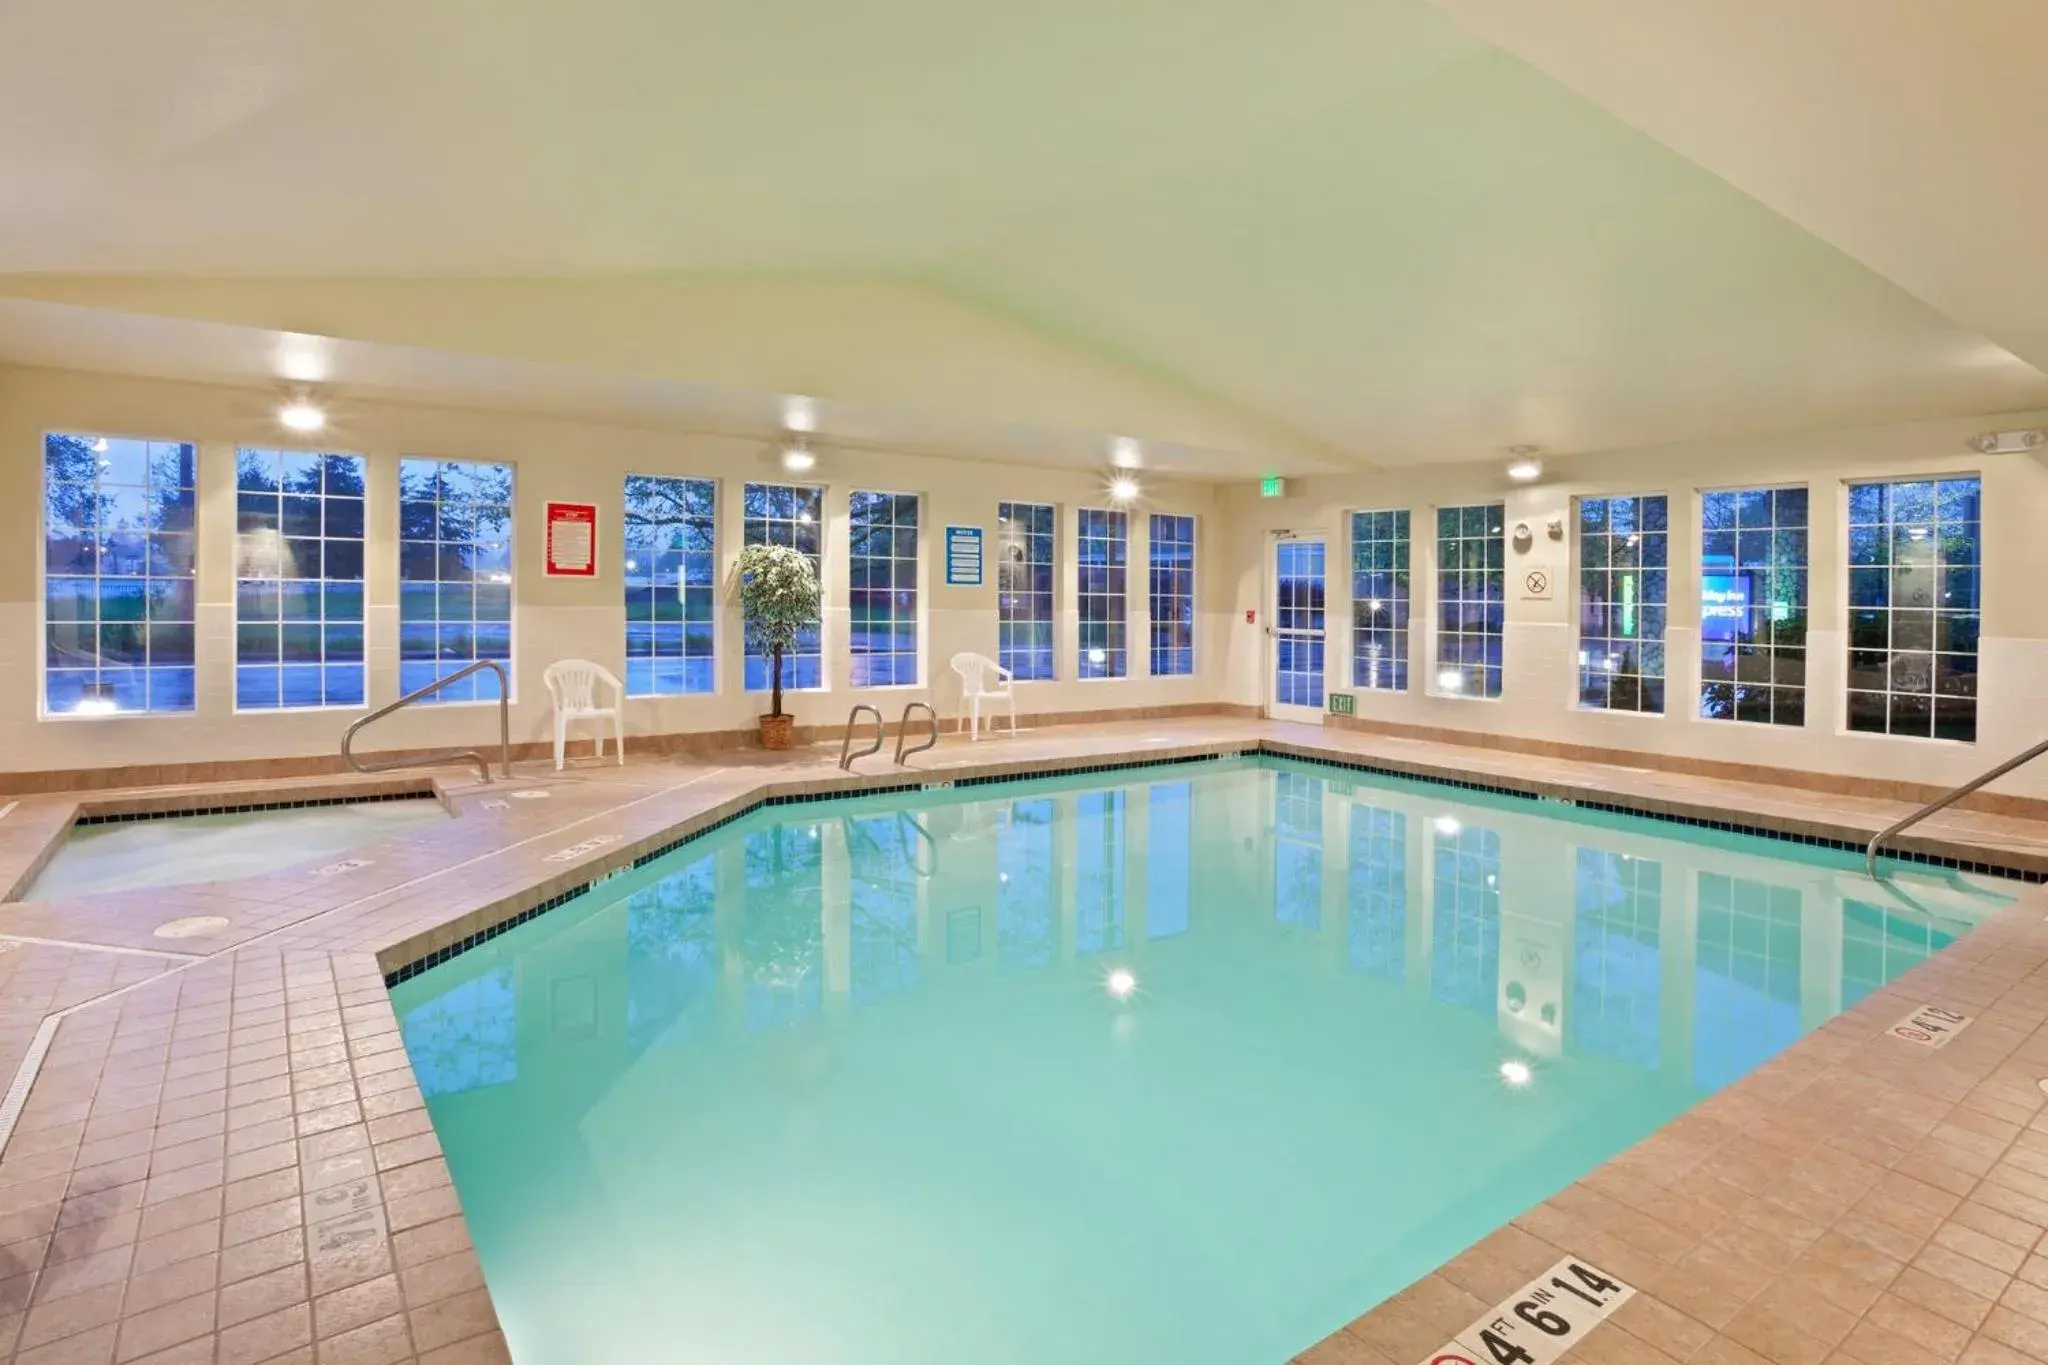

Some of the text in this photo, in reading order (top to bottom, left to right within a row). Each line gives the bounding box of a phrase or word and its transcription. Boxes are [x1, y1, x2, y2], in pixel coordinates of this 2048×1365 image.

[1478, 1263, 1622, 1365] 4 FT 6 IN 1.4
